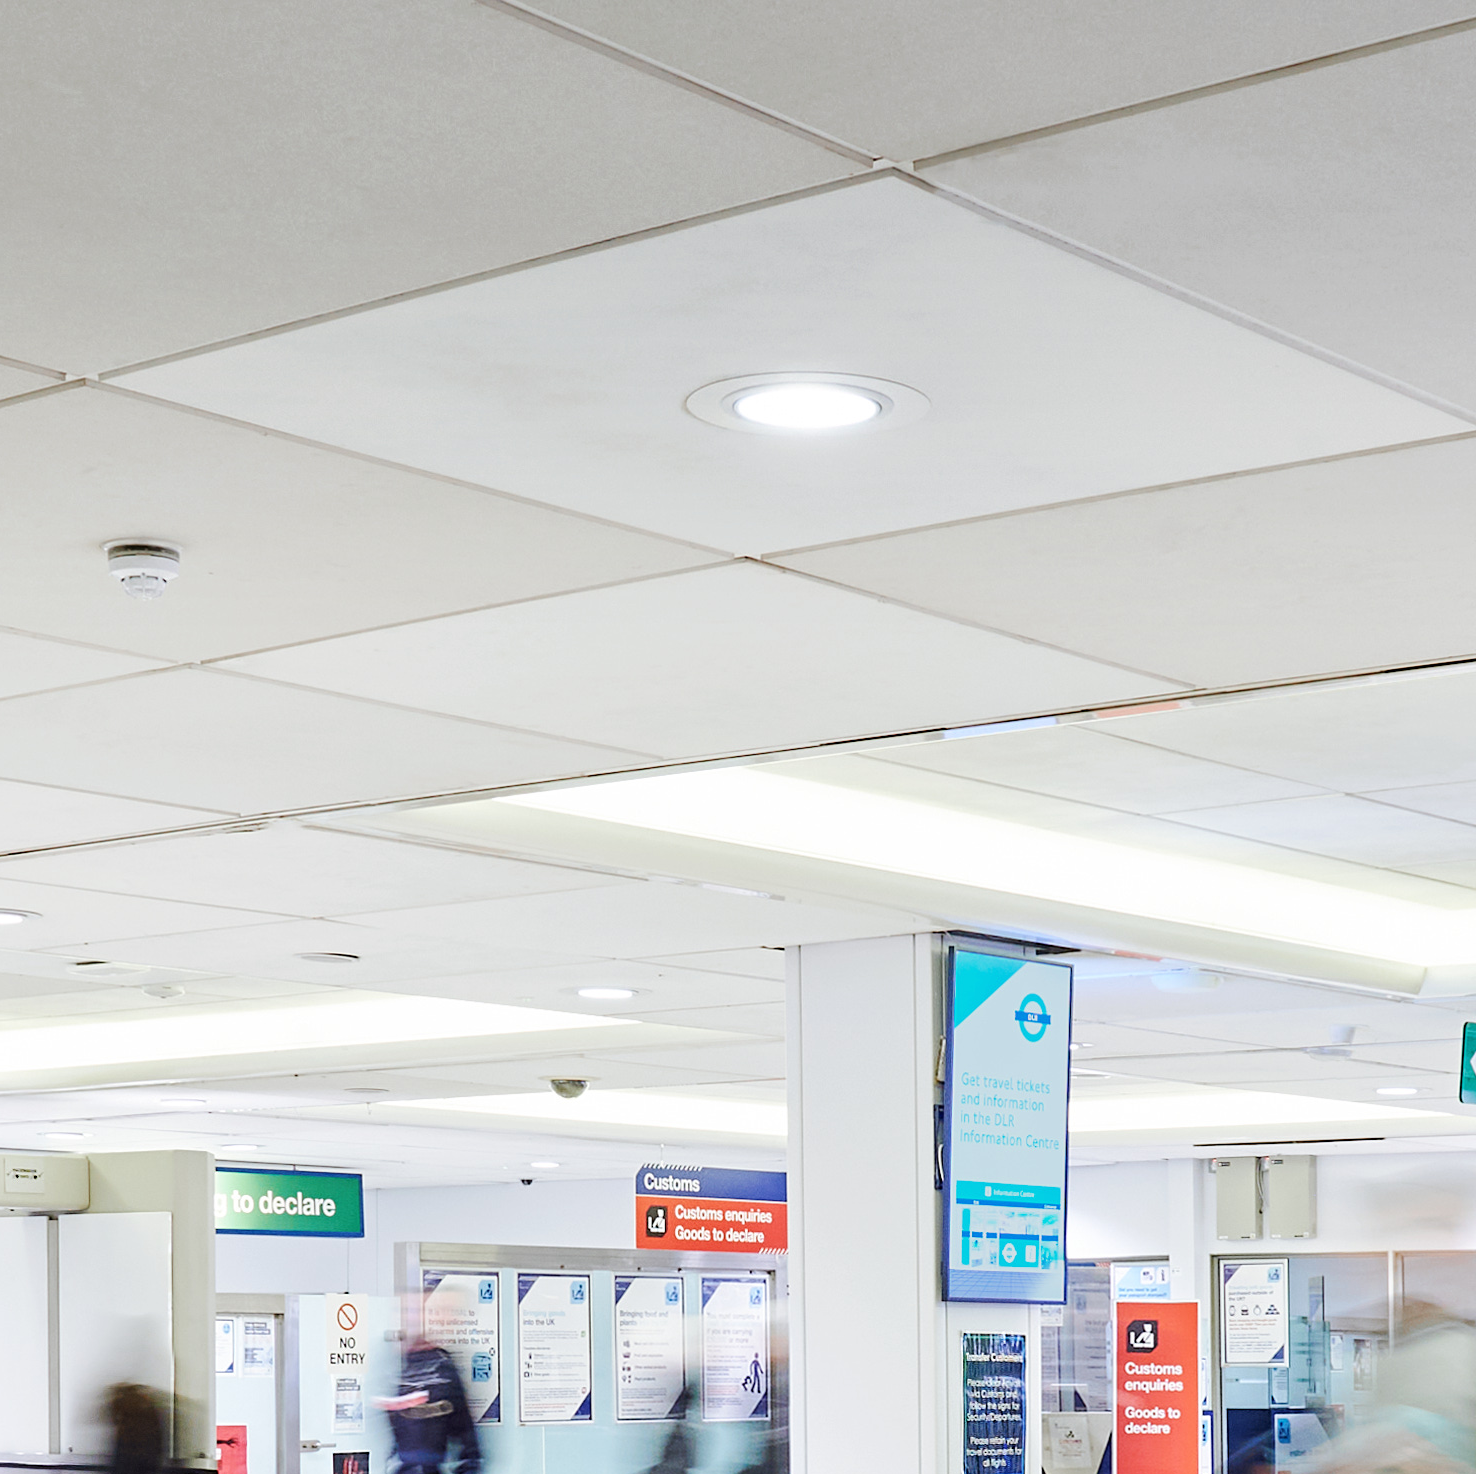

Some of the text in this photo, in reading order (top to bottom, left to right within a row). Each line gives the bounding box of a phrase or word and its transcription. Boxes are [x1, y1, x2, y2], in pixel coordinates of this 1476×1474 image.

[1028, 1013, 1038, 1021] DLR
[961, 1072, 1050, 1094] Get travel tickets
[961, 1092, 1044, 1112] and information
[960, 1110, 1014, 1128] in the DLR
[960, 1128, 1060, 1150] Information Centre
[644, 1172, 701, 1192] Customs
[231, 1189, 255, 1213] to
[259, 1190, 336, 1217] declare
[675, 1204, 772, 1225] Customs enquiries
[675, 1225, 765, 1243] Goods to declare
[339, 1337, 356, 1349] NO
[329, 1353, 365, 1365] ENTRY
[1124, 1362, 1183, 1375] Customs
[1124, 1379, 1183, 1393] enquiries
[1124, 1407, 1181, 1420] Goods to
[1124, 1422, 1170, 1434] declare
